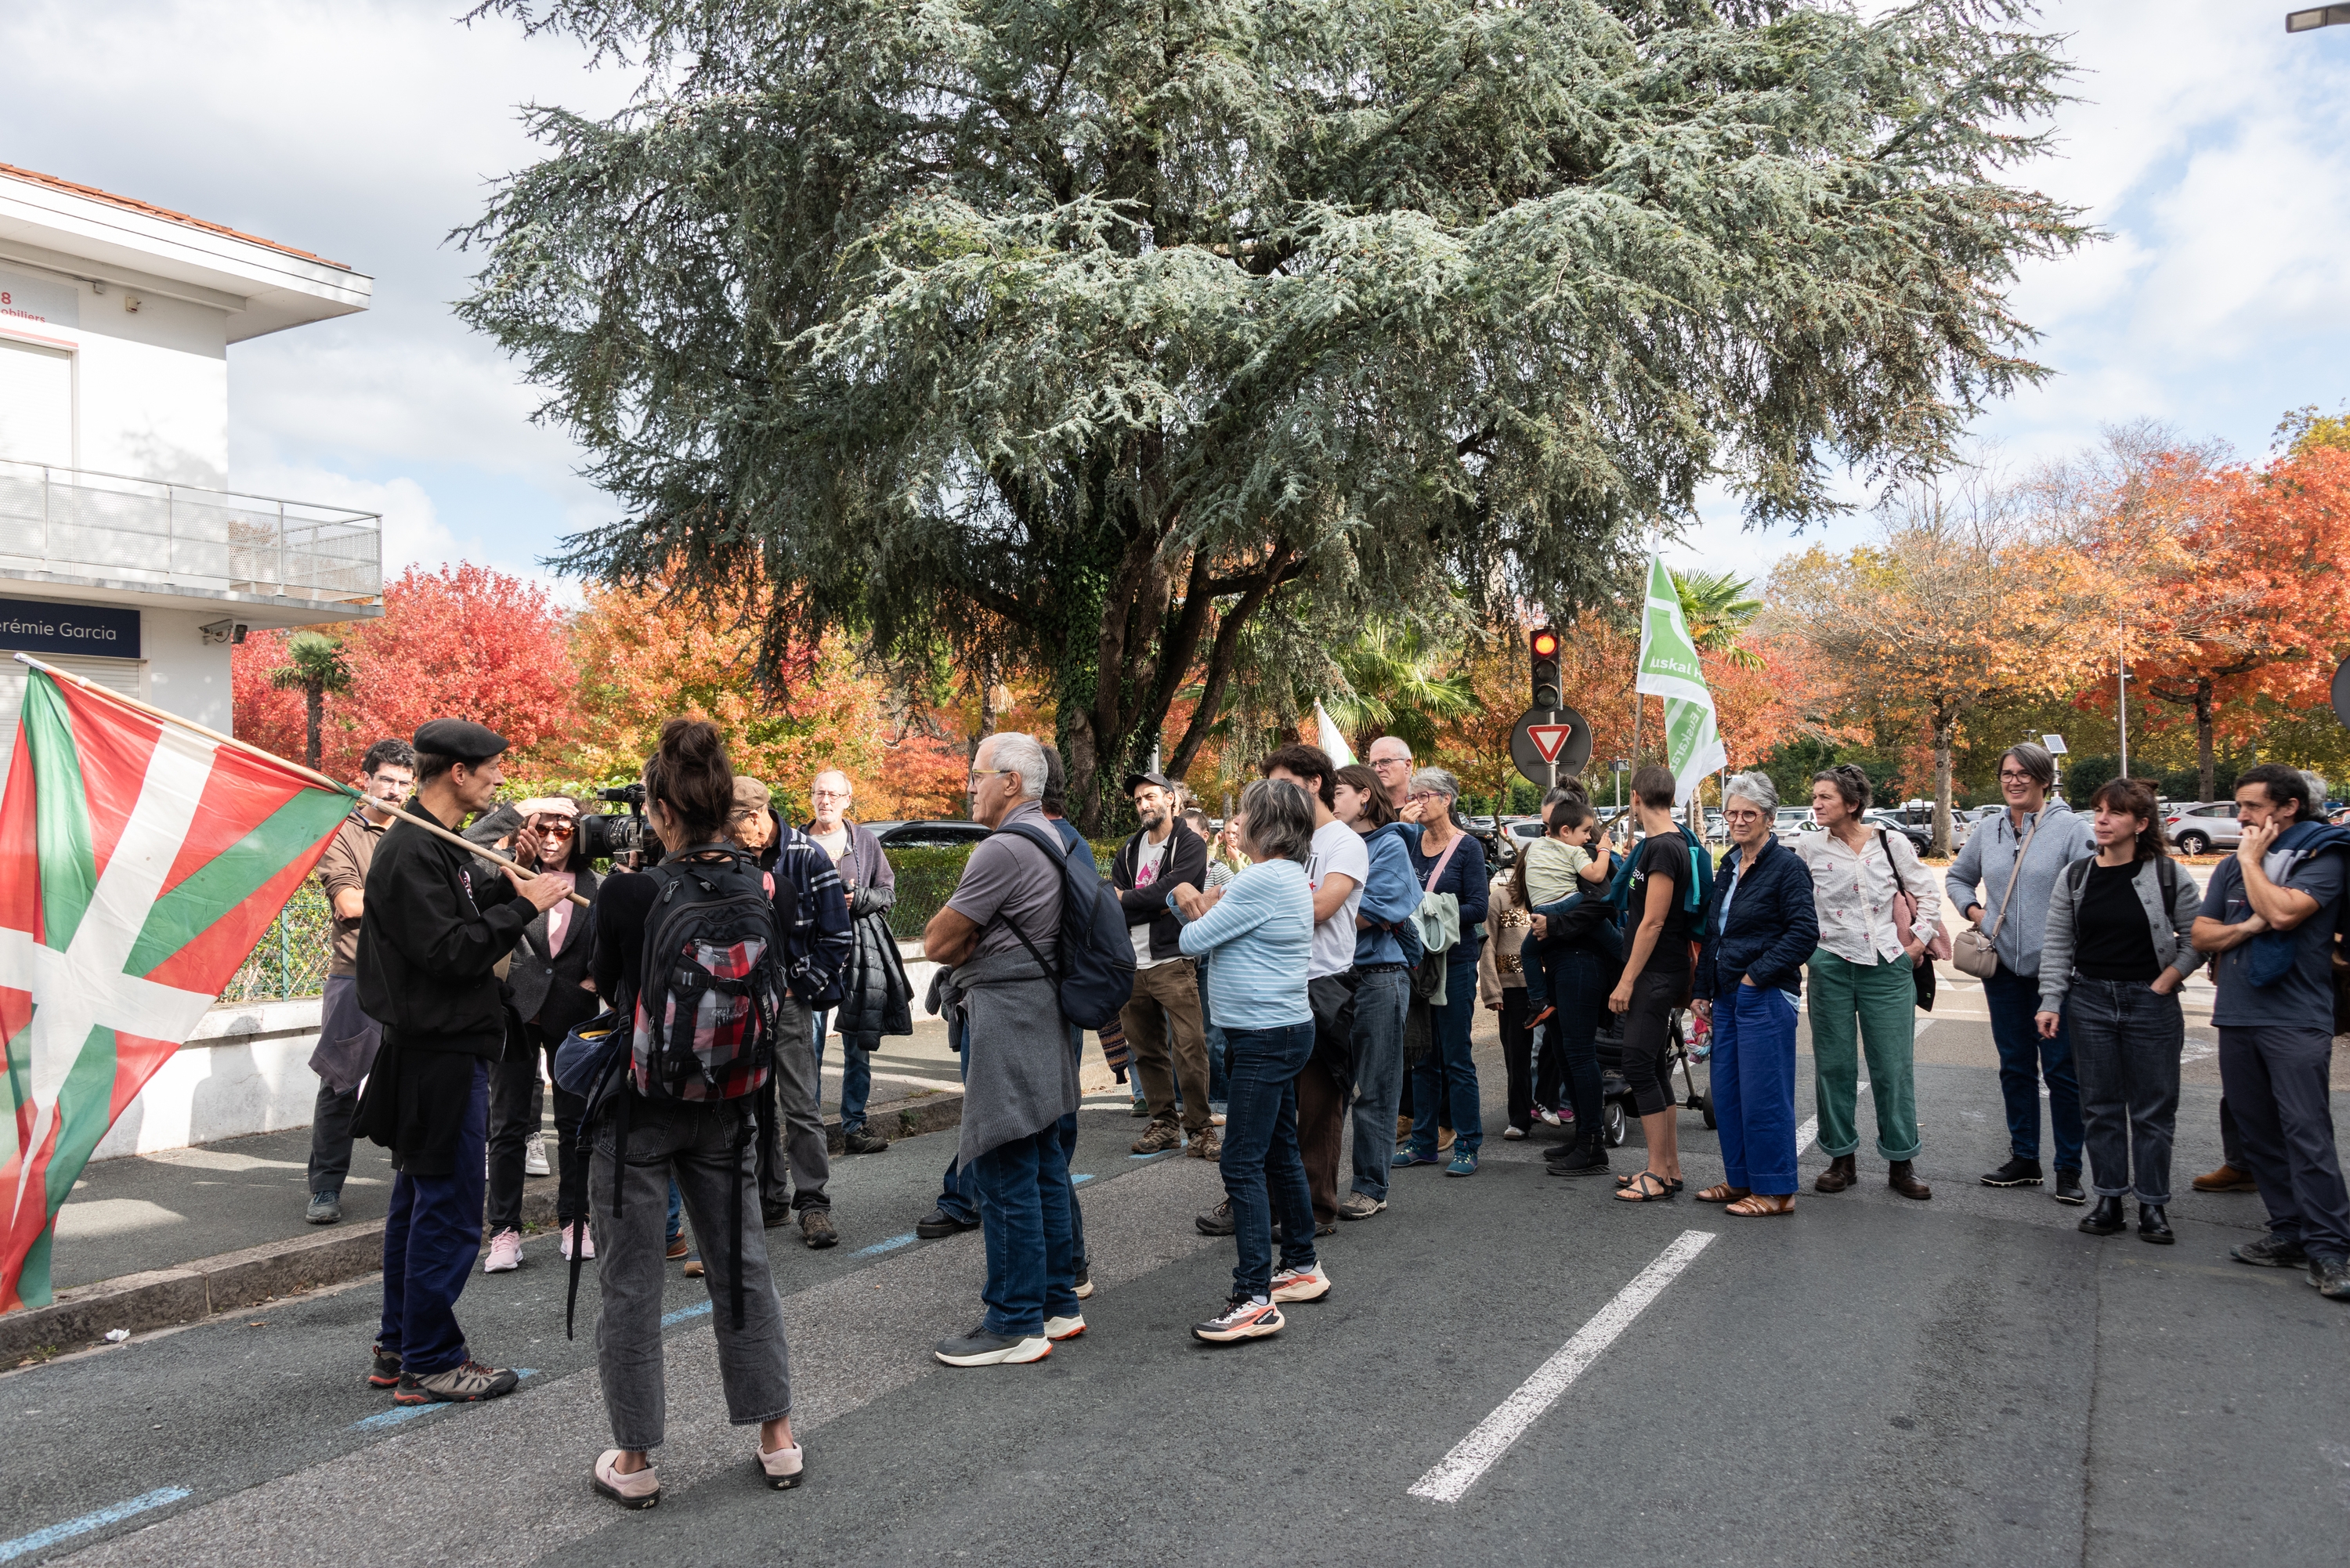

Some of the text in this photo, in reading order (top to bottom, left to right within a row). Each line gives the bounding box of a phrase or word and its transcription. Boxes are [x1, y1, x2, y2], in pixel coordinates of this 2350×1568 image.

[0, 618, 117, 640] rémie Garcia
[1694, 667, 1706, 685] H
[761, 992, 773, 1041] DAKINE
[1257, 1310, 1274, 1324] SALOMON
